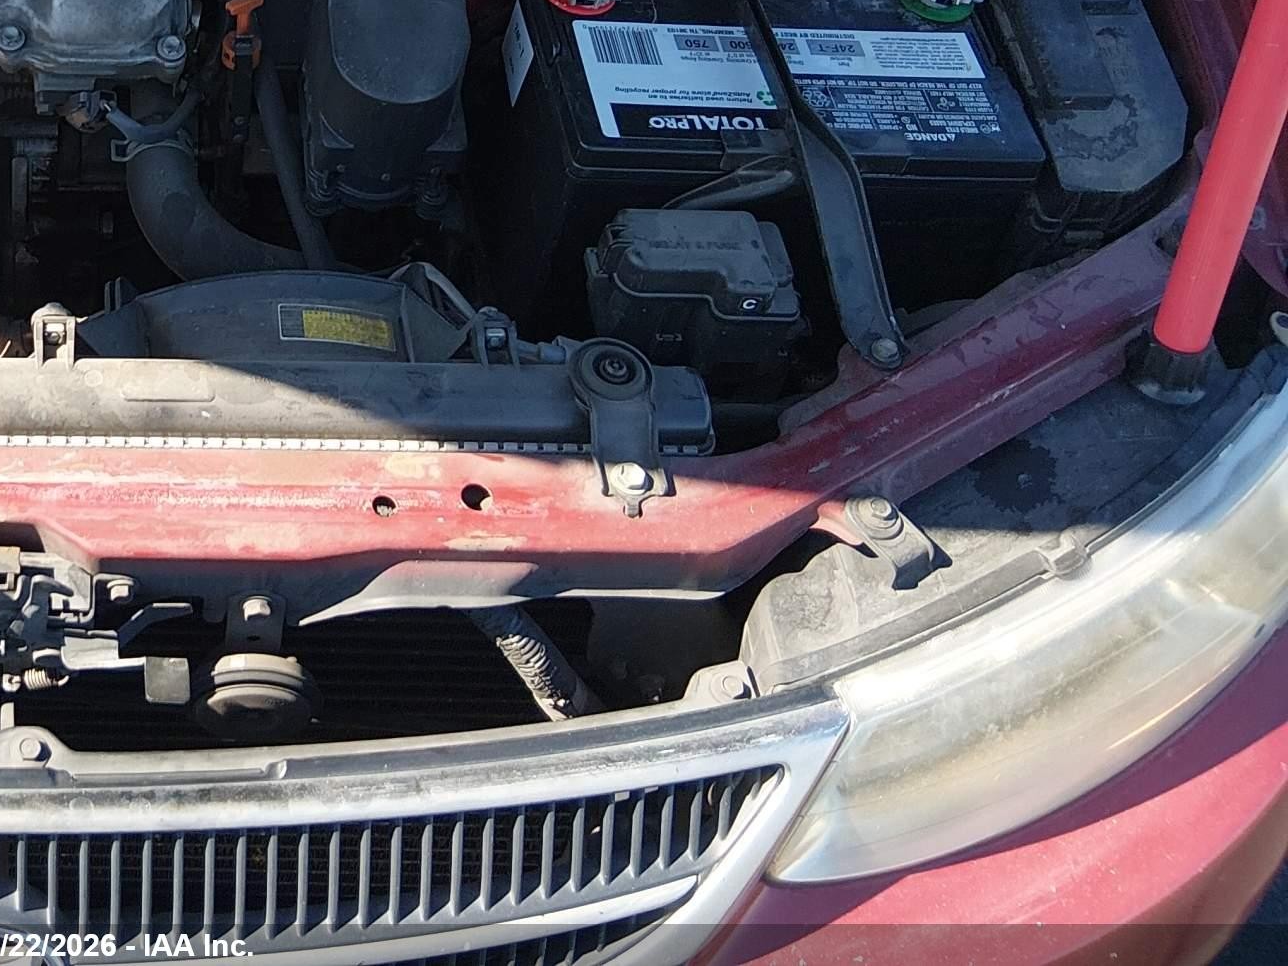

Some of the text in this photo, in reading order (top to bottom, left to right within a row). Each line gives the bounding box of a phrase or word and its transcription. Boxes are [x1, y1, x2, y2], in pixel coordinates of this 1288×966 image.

[684, 39, 710, 48] 750
[818, 44, 856, 53] 24F-T
[649, 115, 769, 131] TOTALPRO
[742, 298, 758, 310] C
